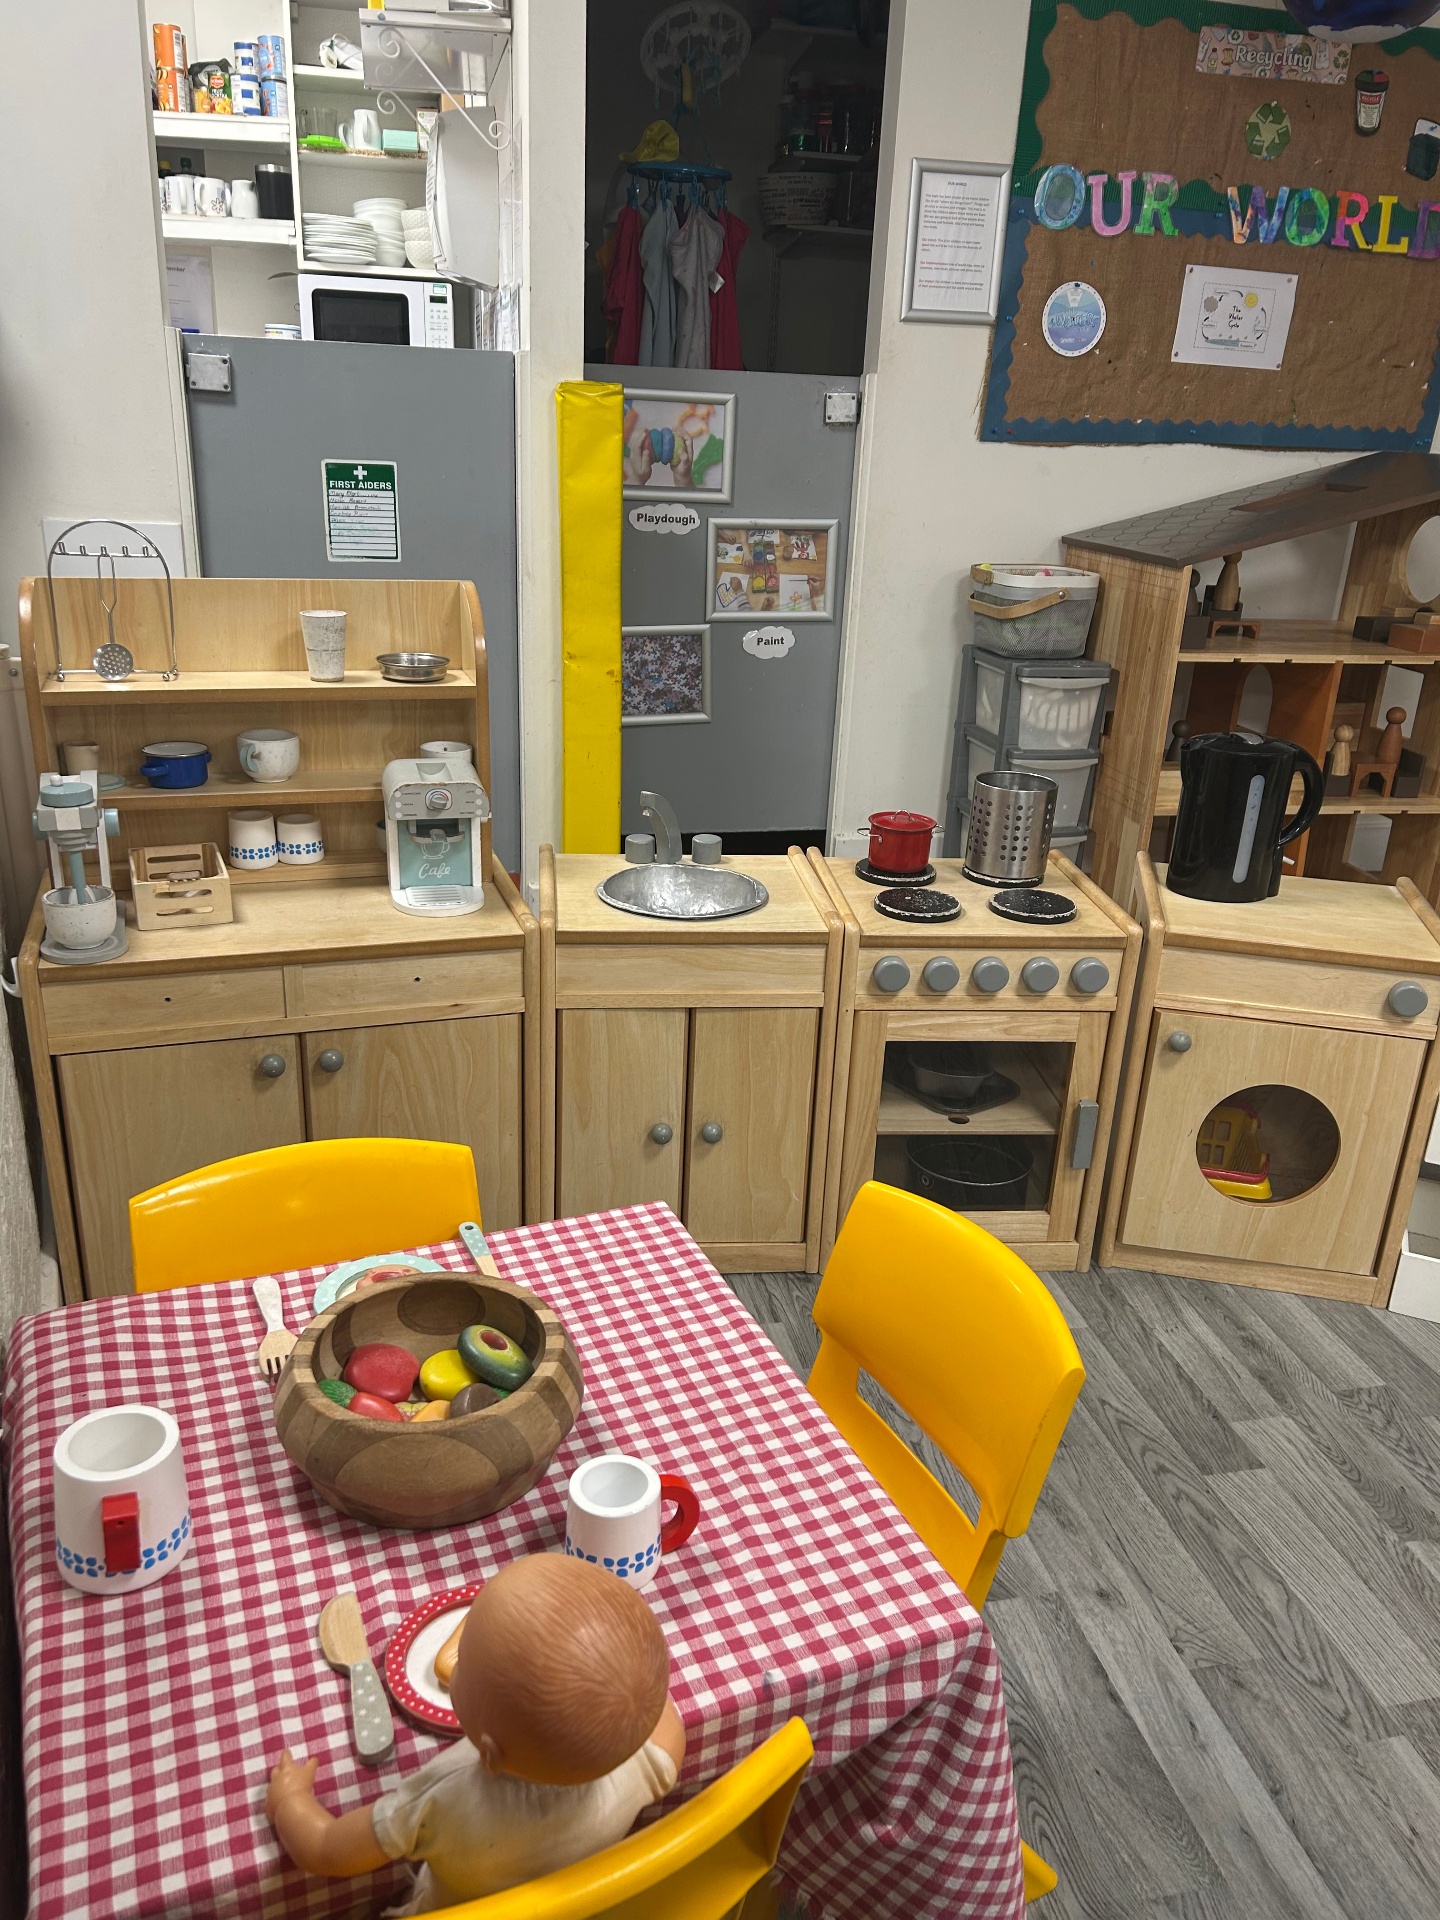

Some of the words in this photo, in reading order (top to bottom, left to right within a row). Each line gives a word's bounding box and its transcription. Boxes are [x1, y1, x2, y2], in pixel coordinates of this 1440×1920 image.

[1235, 44, 1313, 73] Recycling
[1034, 163, 1180, 237] OUR
[1227, 186, 1440, 260] WORLD
[329, 480, 356, 489] FIRST
[358, 481, 392, 490] AIDERS
[636, 513, 696, 526] Playdough
[756, 637, 785, 646] Paint
[418, 862, 451, 879] Cafe
